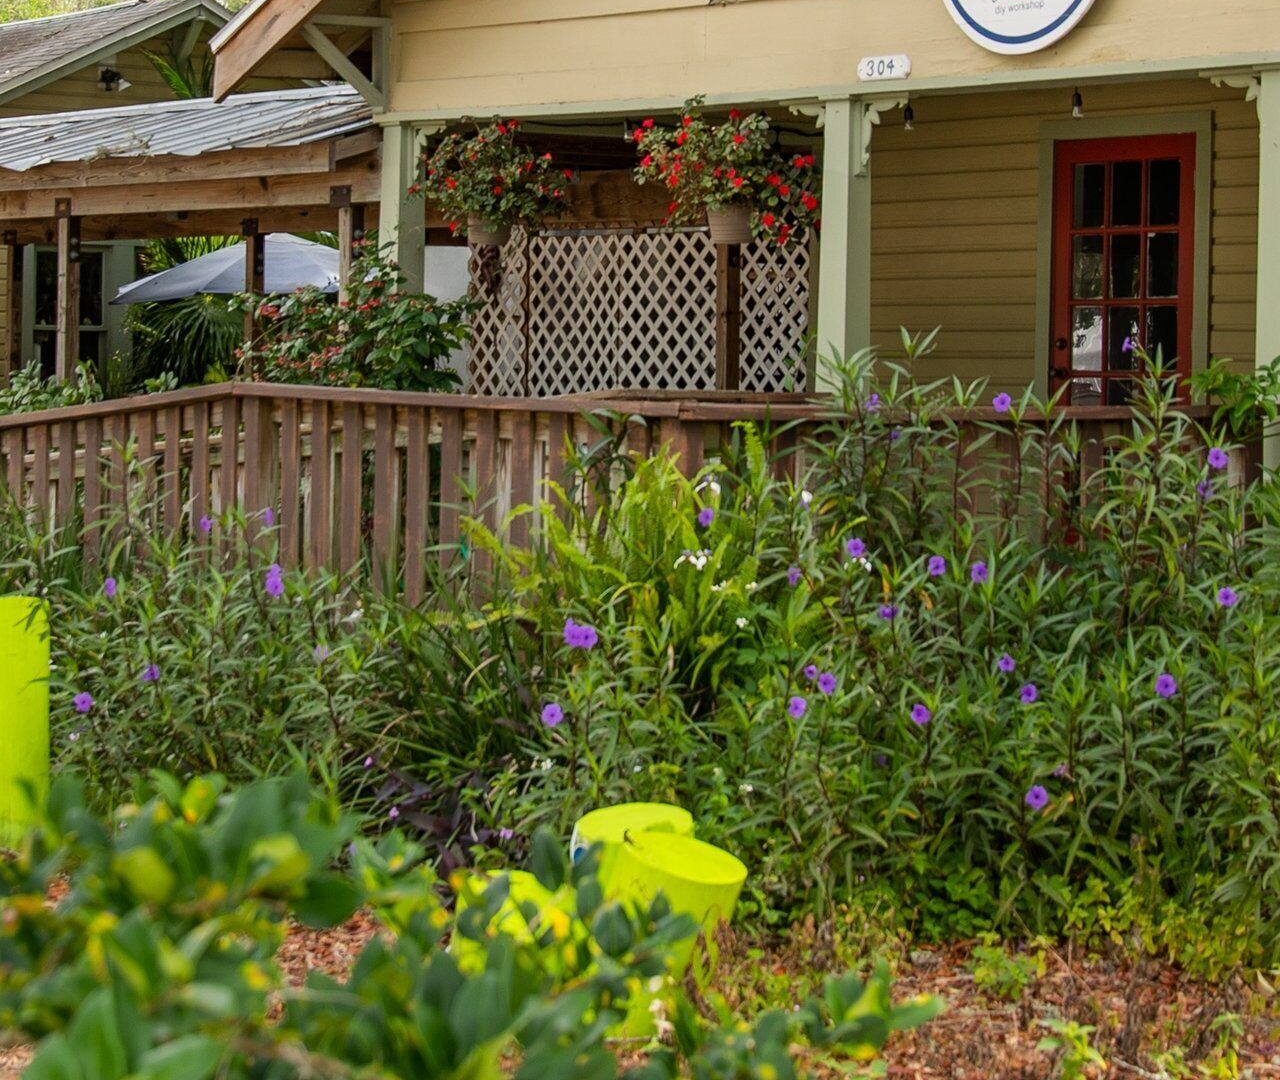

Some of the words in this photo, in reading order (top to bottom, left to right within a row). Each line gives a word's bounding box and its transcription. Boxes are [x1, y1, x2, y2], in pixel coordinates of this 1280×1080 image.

[994, 6, 1006, 16] diy
[1007, 0, 1045, 11] workshop
[866, 59, 895, 77] 304
